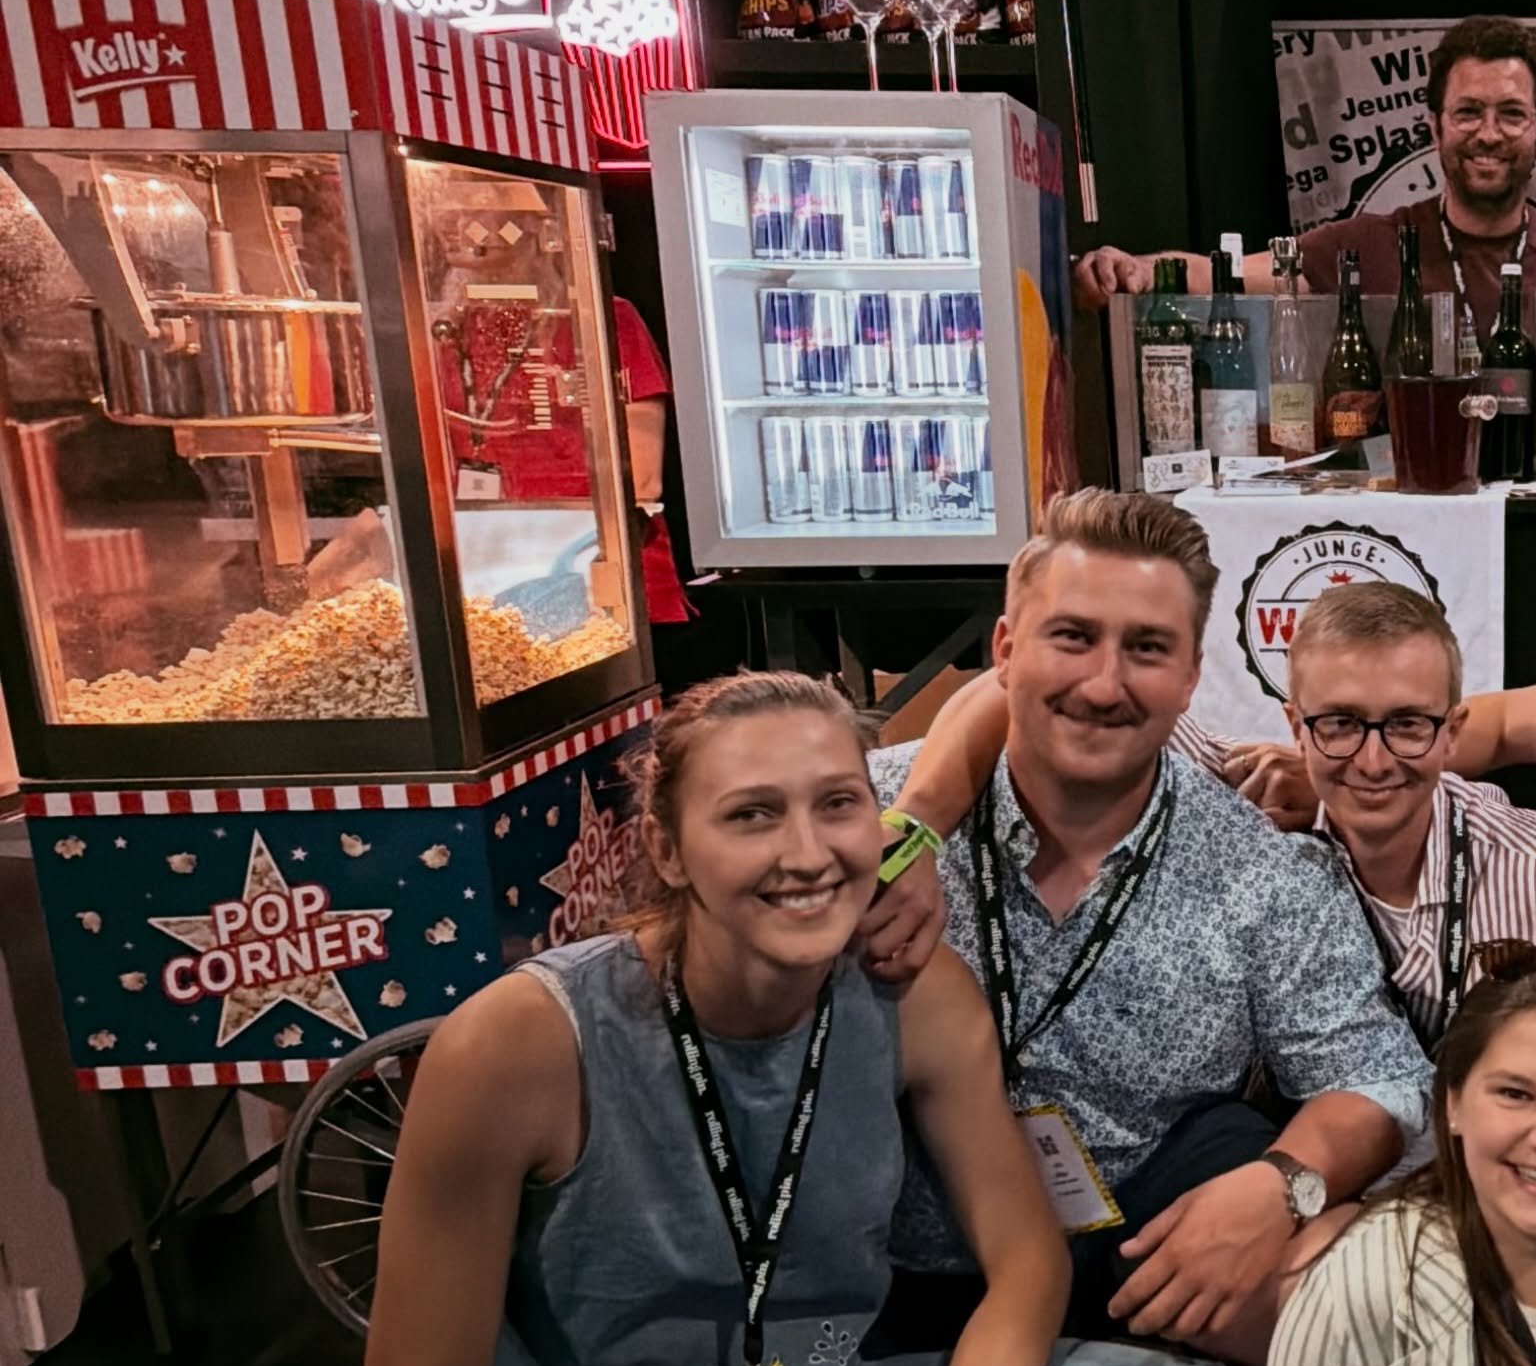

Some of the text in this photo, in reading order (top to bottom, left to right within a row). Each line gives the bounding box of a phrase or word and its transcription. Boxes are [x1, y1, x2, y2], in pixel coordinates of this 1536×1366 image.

[764, 26, 795, 38] PACK
[1303, 539, 1377, 563] JUNGE
[568, 809, 614, 885] POP
[550, 826, 639, 948] CORNER
[213, 884, 326, 945] POP
[165, 916, 385, 1000] CORNER
[680, 1033, 703, 1075] rolling
[704, 1110, 725, 1149] rolling
[791, 1114, 811, 1154] rolling
[768, 1173, 794, 1240] rolling pin.
